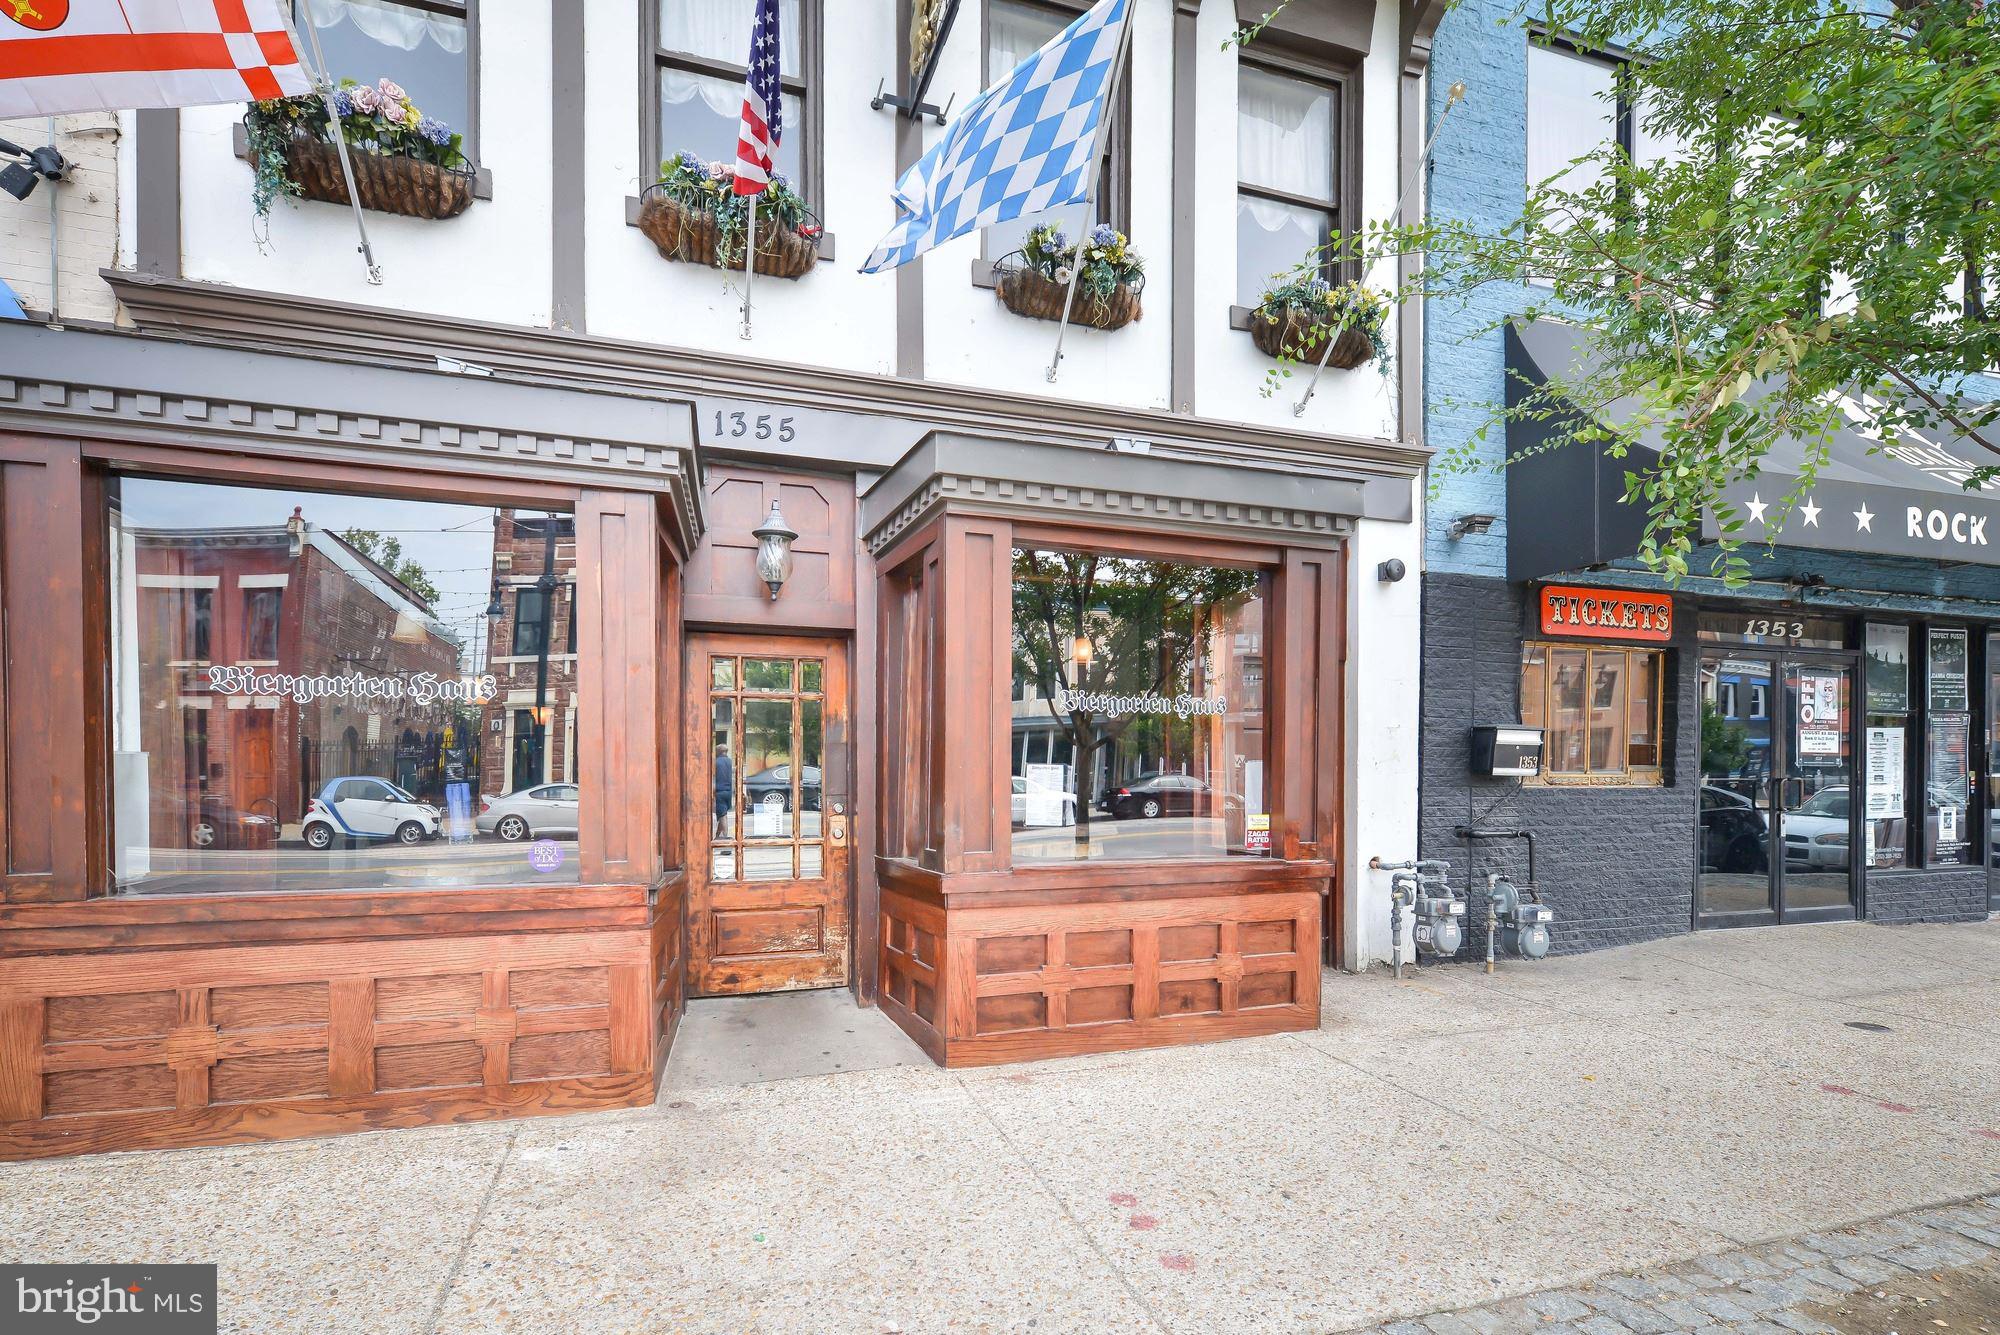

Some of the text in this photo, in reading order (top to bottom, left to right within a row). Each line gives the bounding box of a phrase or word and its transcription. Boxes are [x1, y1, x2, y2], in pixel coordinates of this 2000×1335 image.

[715, 411, 795, 442] 1355
[1906, 506, 1988, 546] ROCK
[1549, 595, 1669, 631] TICKETS
[1744, 620, 1804, 638] 1353
[208, 665, 498, 705] Biergarten Haus
[1801, 675, 1815, 724] OFF!
[1058, 689, 1228, 720] Biergarten Haus
[1519, 756, 1538, 769] 1353
[534, 846, 560, 855] BEST
